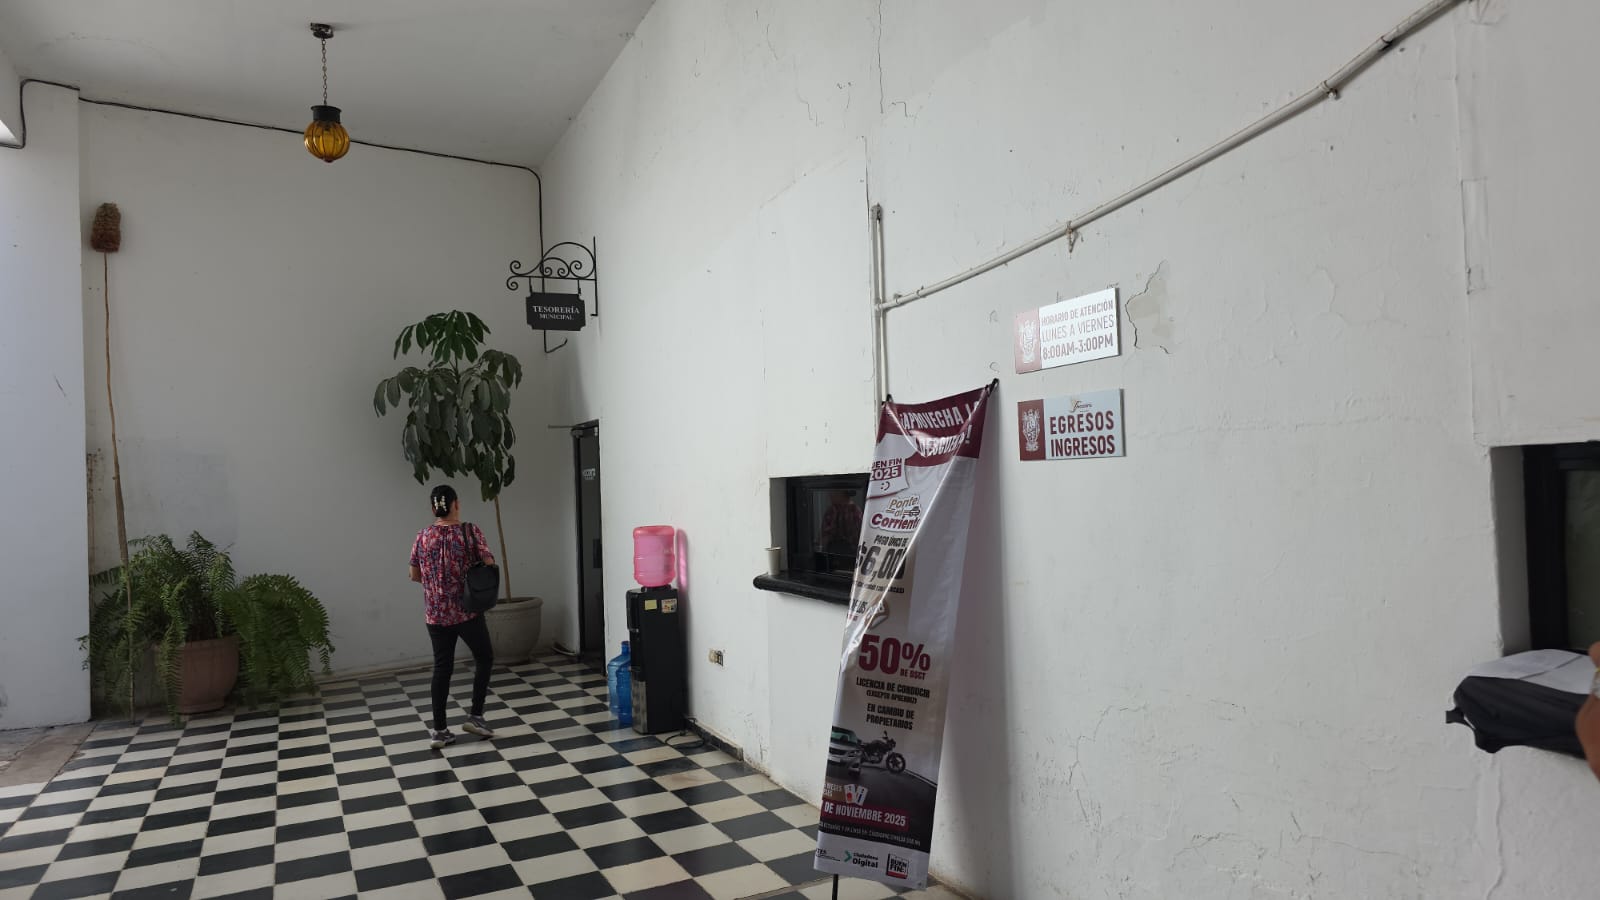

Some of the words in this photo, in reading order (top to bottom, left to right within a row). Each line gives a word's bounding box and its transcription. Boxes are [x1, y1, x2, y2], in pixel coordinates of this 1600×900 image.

[532, 305, 580, 314] TESORERÍA
[1041, 311, 1069, 326] HORARIO
[1070, 308, 1079, 320] DE
[1080, 299, 1114, 318] ATENCIÓN
[1042, 325, 1068, 343] LUNES
[1069, 324, 1076, 337] A
[1078, 314, 1114, 335] VIERNES
[1042, 333, 1114, 361] 8:00AM-3:00PM
[1050, 410, 1115, 435] EGRESOS
[1051, 434, 1115, 458] INGRESOS
[870, 467, 898, 480] 2025
[889, 496, 919, 509] Ponte
[858, 633, 931, 675] 50%
[856, 676, 885, 690] LICENCIA
[886, 681, 895, 692] DE
[866, 713, 913, 730] PROPIETARIOS
[867, 703, 876, 712] EN
[877, 705, 904, 717] CAMBIO
[906, 709, 915, 720] DE
[824, 801, 835, 814] DE
[835, 805, 883, 822] NOVIEMBRE
[884, 812, 906, 827] 2025
[852, 858, 878, 869] Digital
